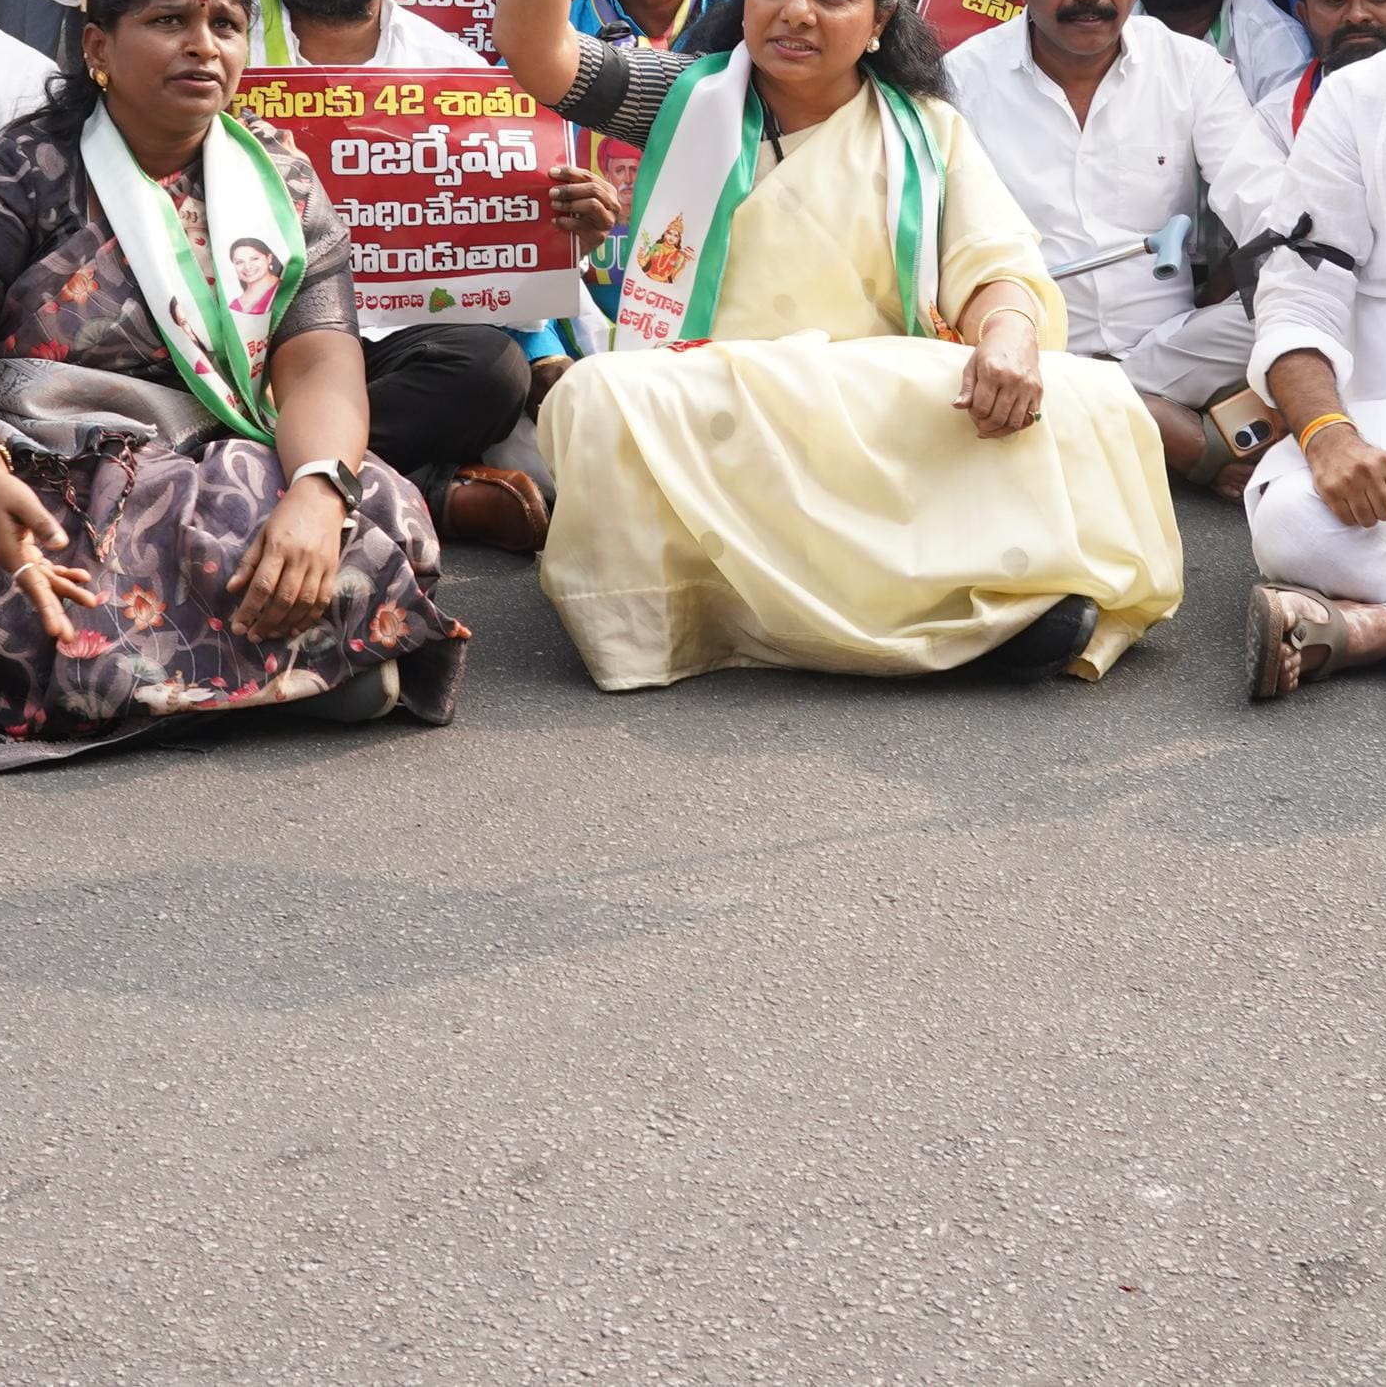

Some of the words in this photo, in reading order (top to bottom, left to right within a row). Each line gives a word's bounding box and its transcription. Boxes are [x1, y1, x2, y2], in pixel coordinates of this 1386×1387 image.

[374, 84, 424, 116] 42
[433, 86, 537, 118] శాతం
[331, 124, 537, 187] రిజర్వేషన్
